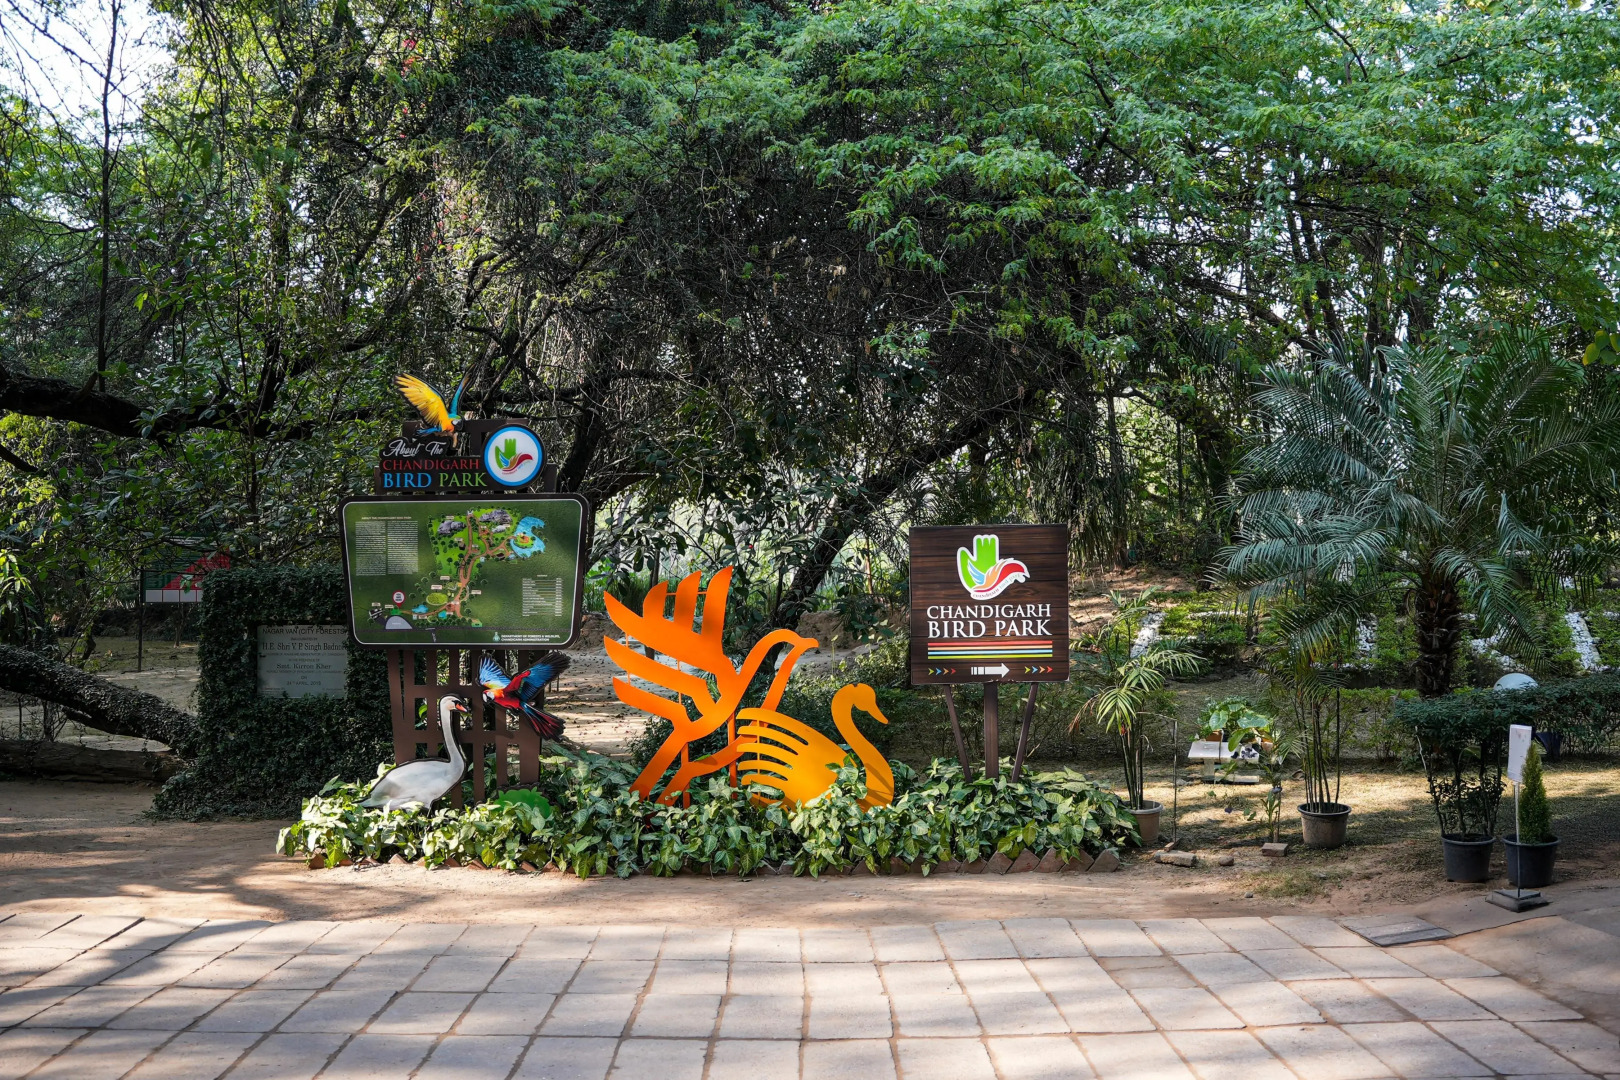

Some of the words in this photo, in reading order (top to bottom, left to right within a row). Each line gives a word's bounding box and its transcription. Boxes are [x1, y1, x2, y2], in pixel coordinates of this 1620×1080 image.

[383, 439, 424, 457] About
[425, 441, 447, 456] The
[382, 458, 481, 471] CHANDIGARH
[383, 472, 432, 488] BIRD
[439, 472, 488, 487] PARK
[926, 603, 1051, 619] CHANDIGARH
[298, 628, 315, 636] (CITY
[927, 620, 986, 639] BIRD
[994, 619, 1053, 637] PARK
[277, 642, 290, 651] Shri
[304, 642, 322, 652] Singh
